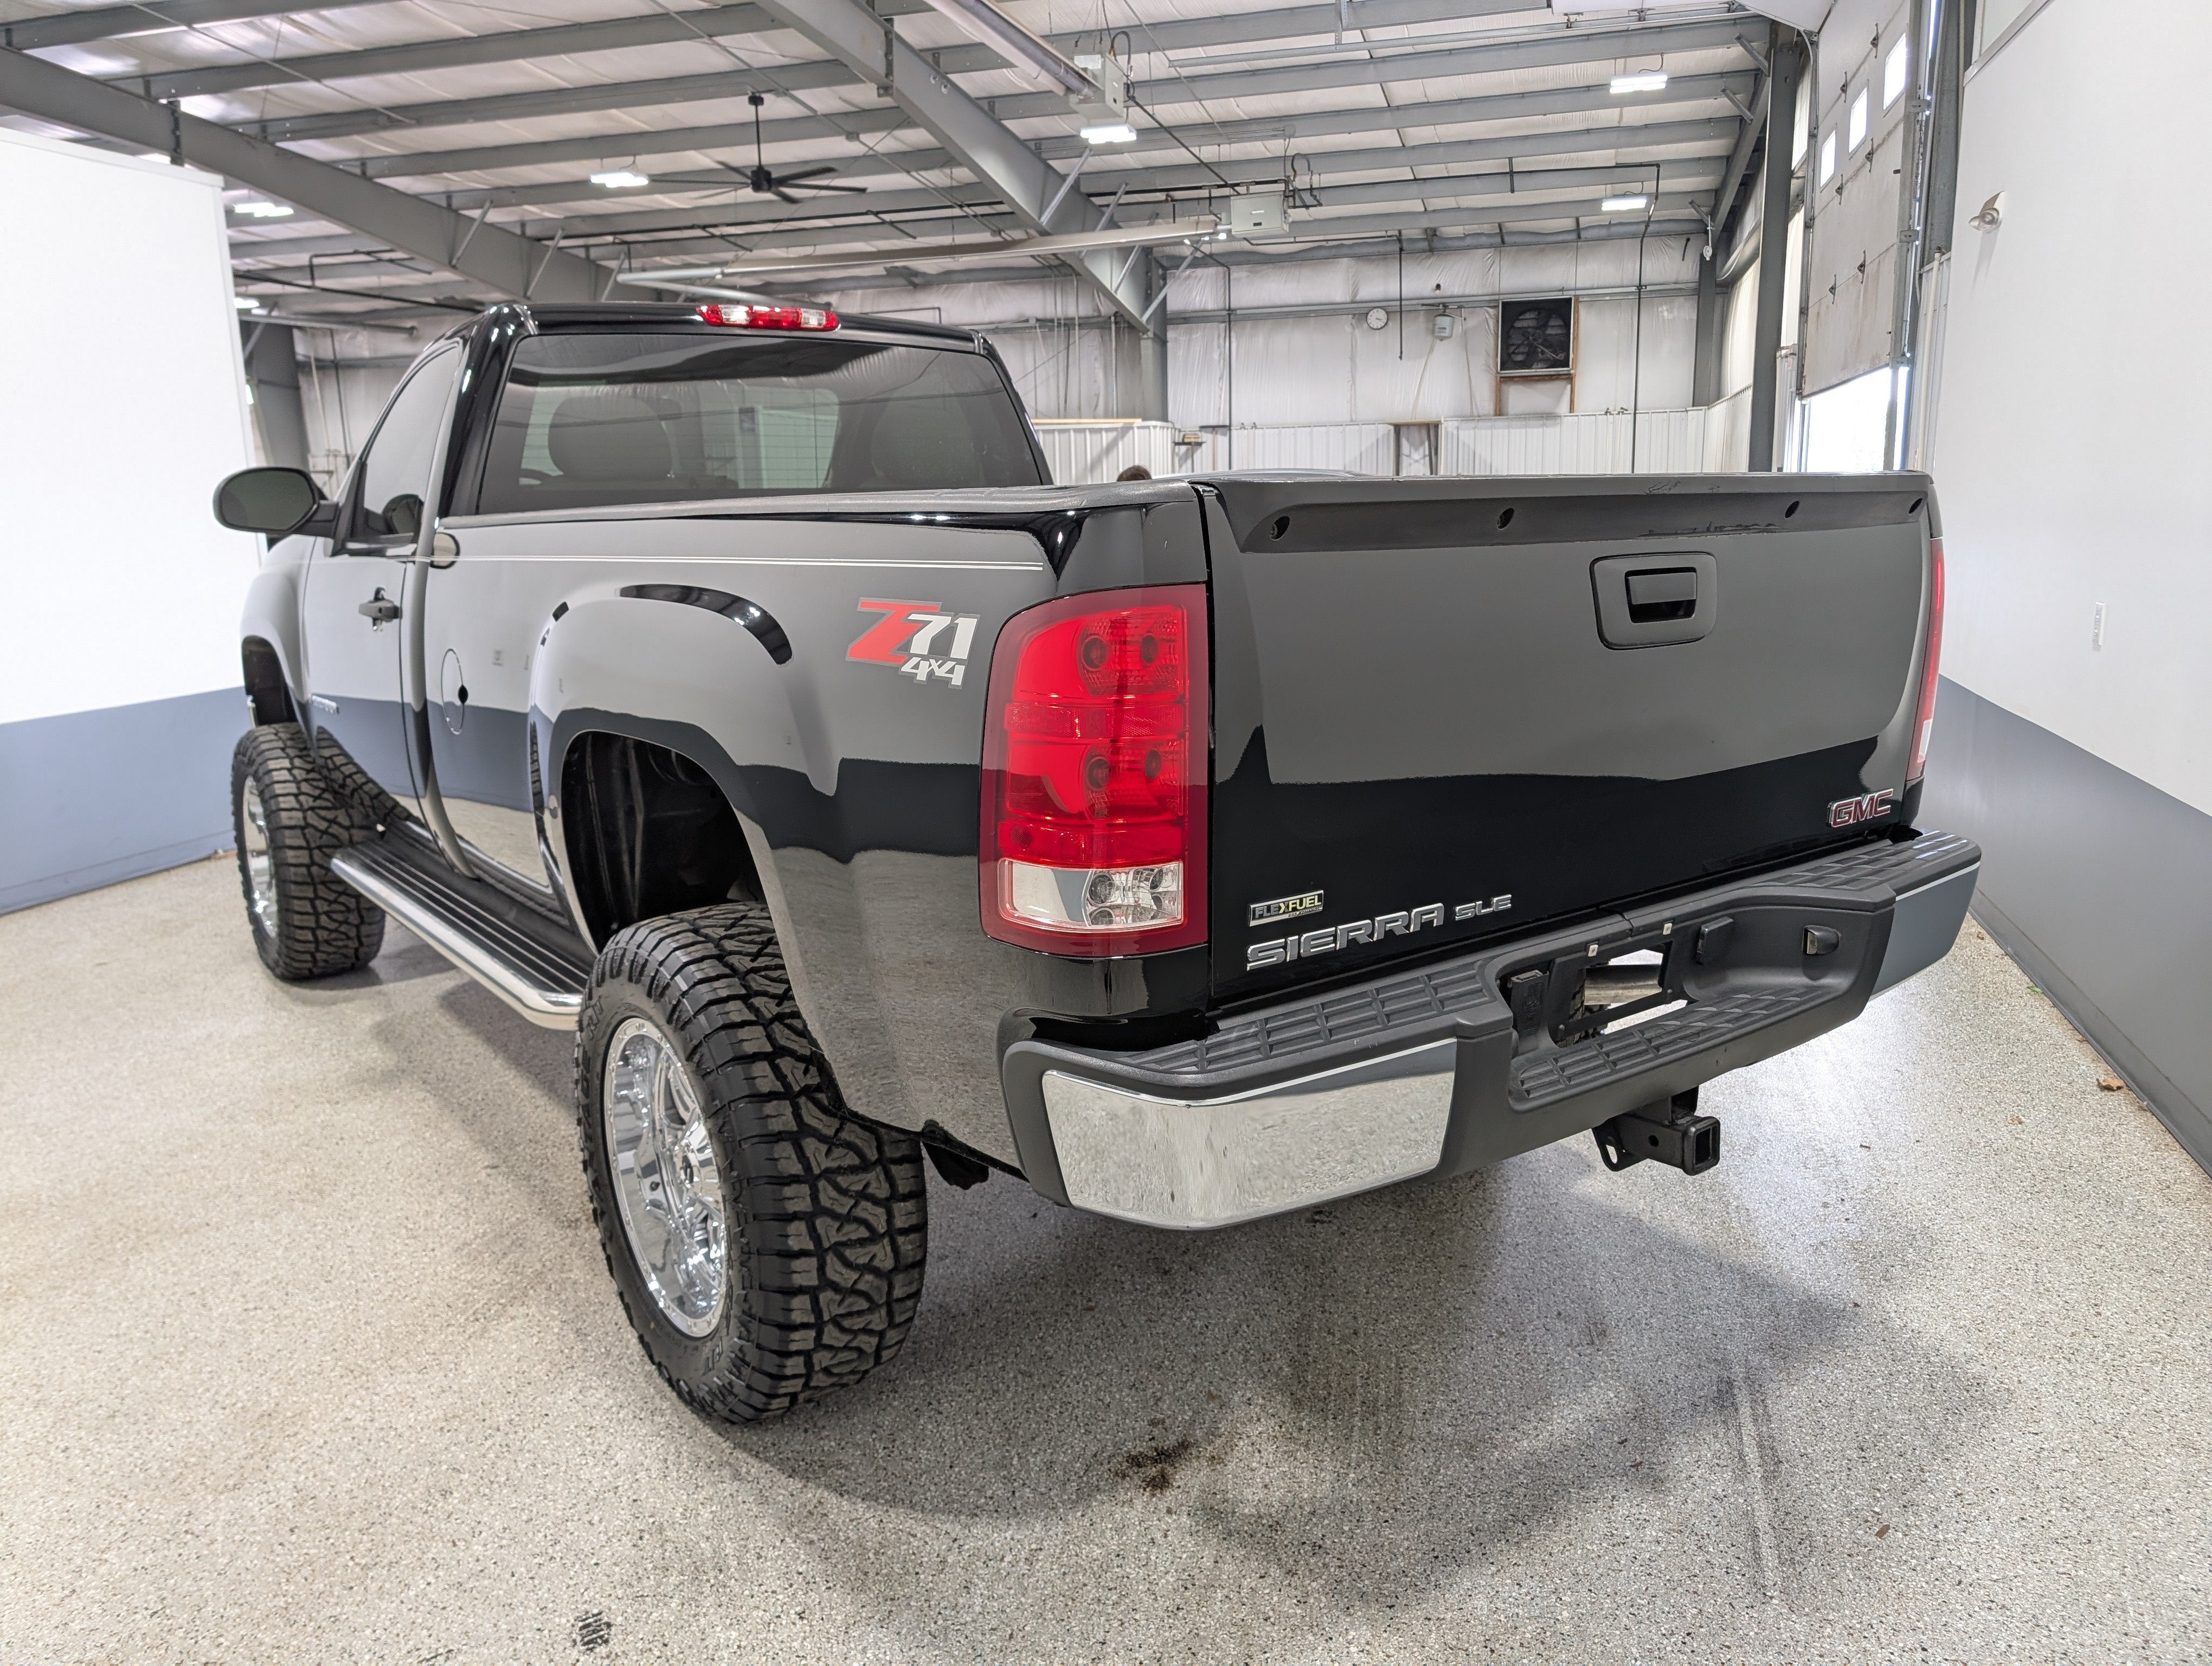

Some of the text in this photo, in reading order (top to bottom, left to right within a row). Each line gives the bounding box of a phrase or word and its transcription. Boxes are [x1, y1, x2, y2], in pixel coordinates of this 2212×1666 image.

[847, 599, 978, 665] Z71
[1828, 788, 1894, 828] GMC
[1246, 894, 1512, 971] SIERRA SLE
